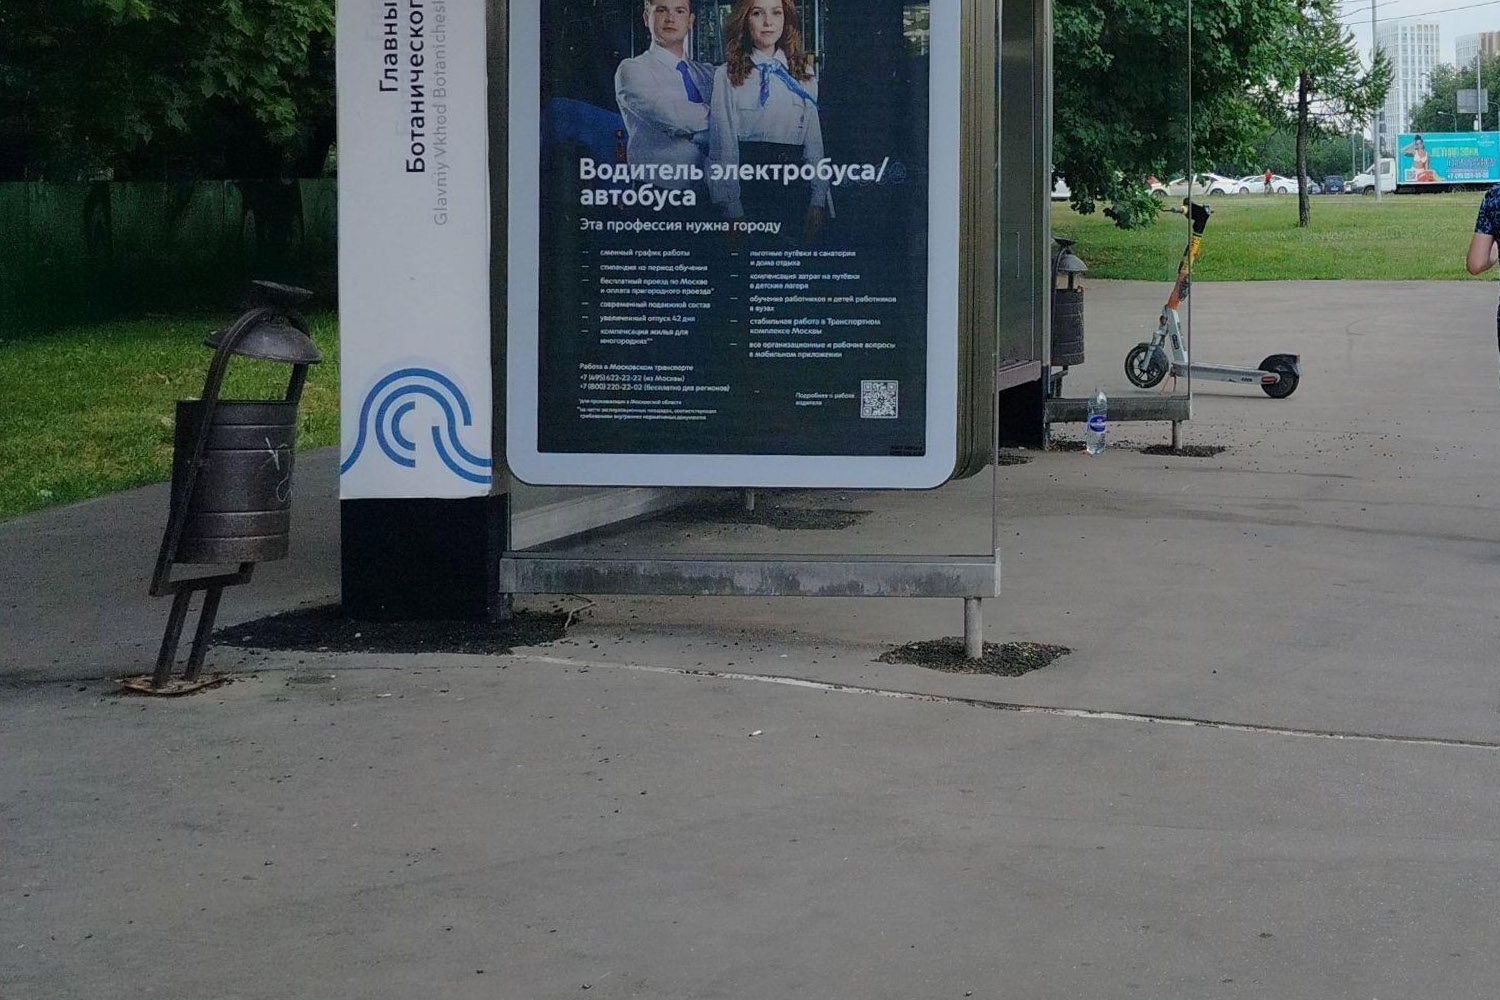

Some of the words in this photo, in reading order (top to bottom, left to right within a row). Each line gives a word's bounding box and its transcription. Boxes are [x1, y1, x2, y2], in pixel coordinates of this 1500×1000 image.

[579, 157, 704, 183] Водитель
[710, 156, 890, 186] электробуса/
[433, 161, 450, 226] Glavniy
[579, 184, 697, 211] автобуса
[579, 219, 604, 232] Эта
[606, 218, 683, 234] профессия
[685, 221, 730, 232] нужна
[733, 221, 782, 234] городу
